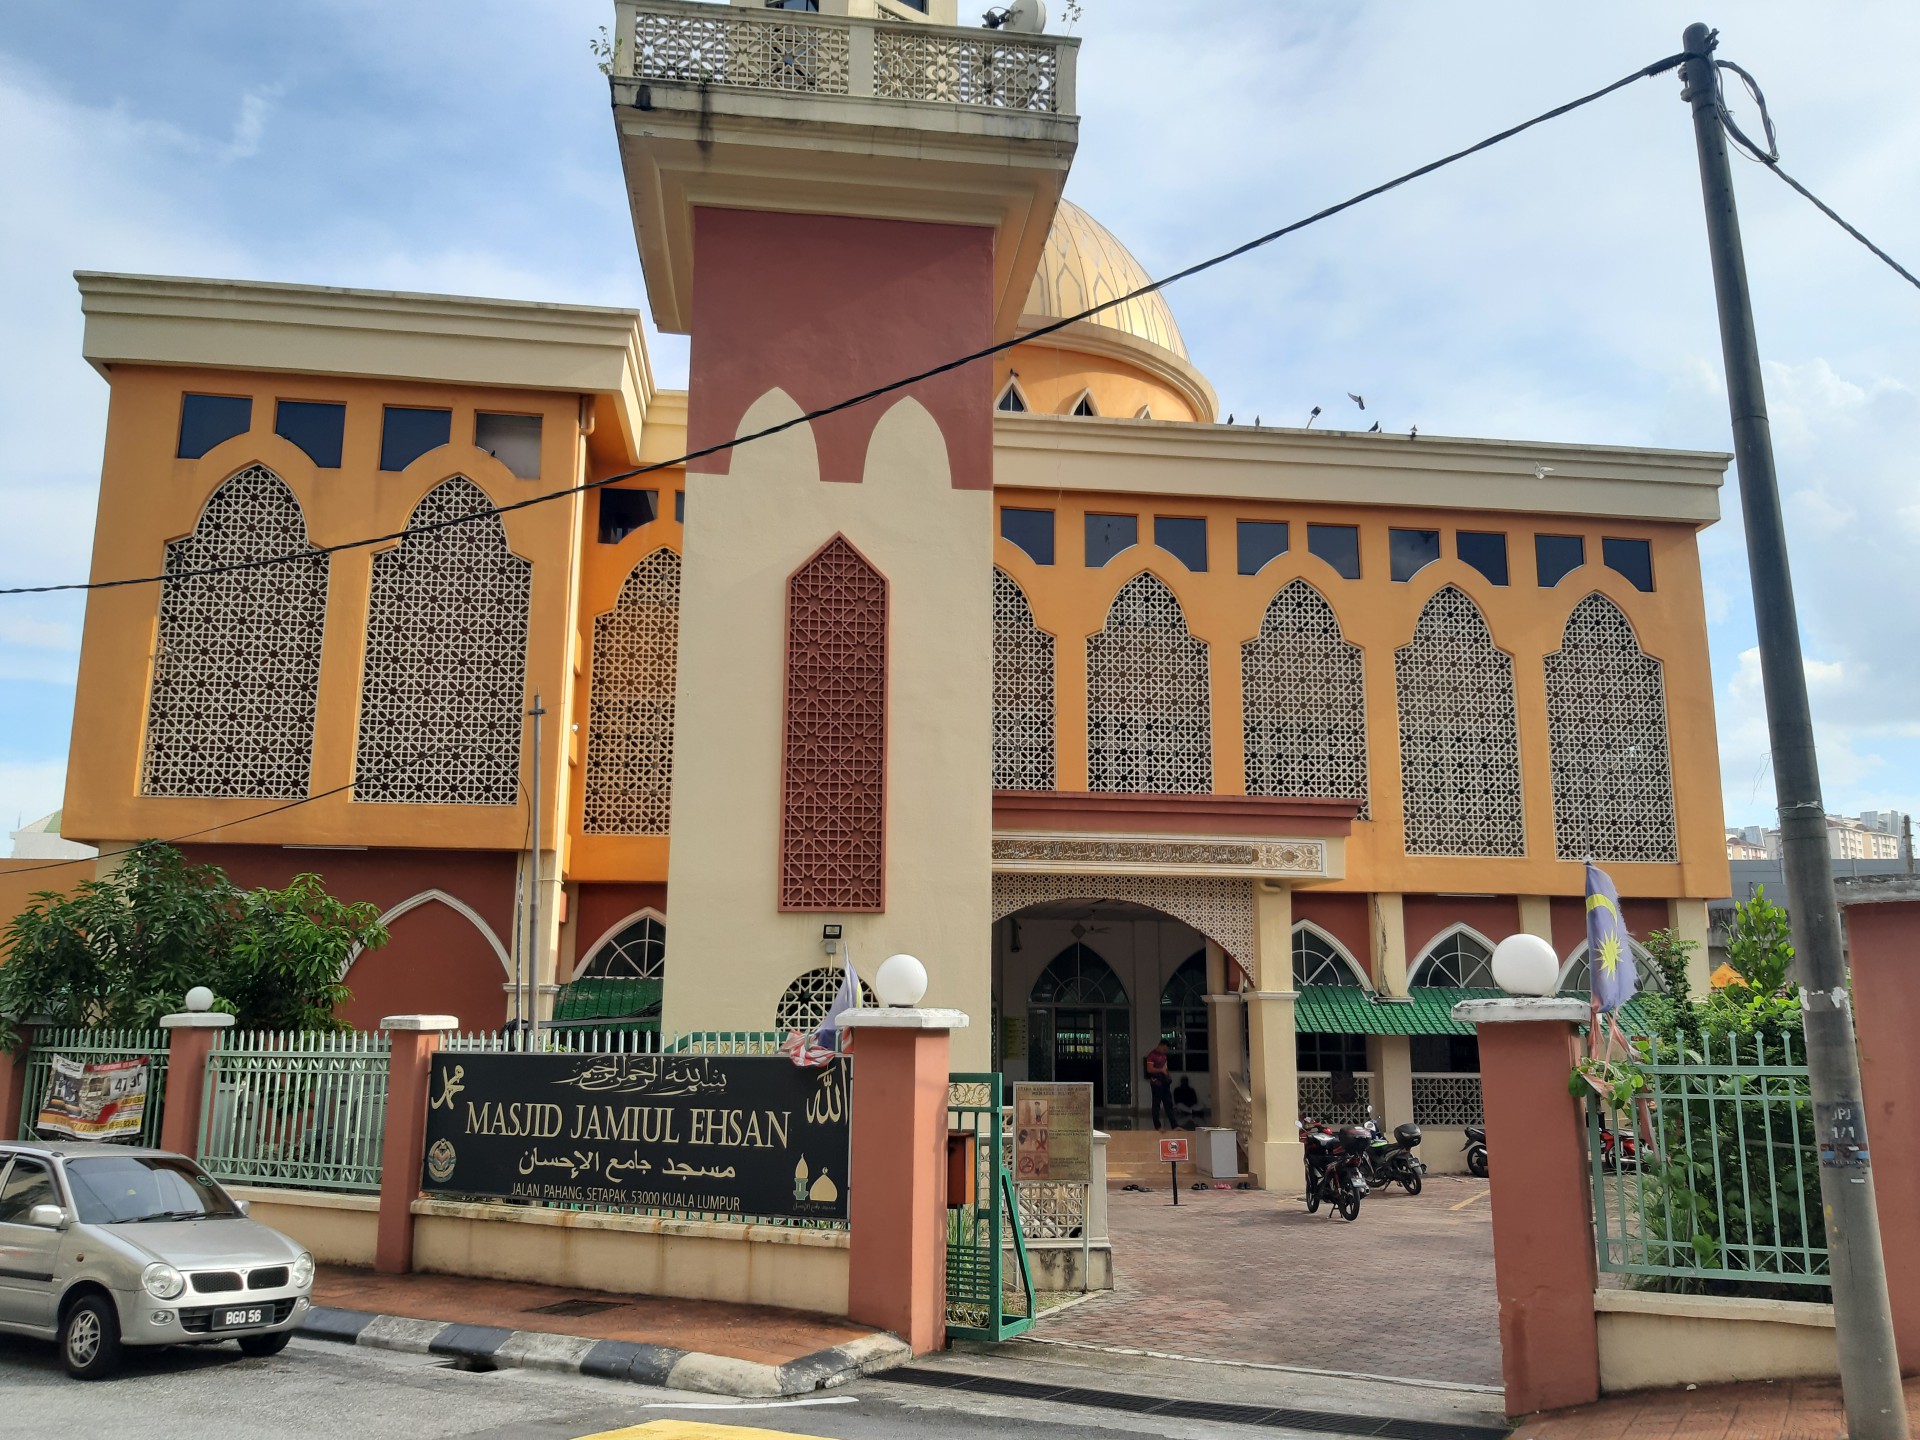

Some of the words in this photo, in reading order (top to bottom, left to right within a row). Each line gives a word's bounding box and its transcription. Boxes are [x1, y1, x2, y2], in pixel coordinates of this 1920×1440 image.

[465, 1101, 563, 1138] MASJID
[570, 1104, 680, 1143] JAMIUL
[688, 1108, 792, 1149] EHSAN
[605, 1149, 652, 1183] جامع
[662, 1157, 736, 1180] مسجد
[511, 1182, 540, 1197] JALAN
[544, 1184, 584, 1201] PAHANG,
[631, 1190, 660, 1205] 53000
[662, 1192, 695, 1207] KUALA
[697, 1194, 741, 1211] LUMPUR
[248, 1309, 262, 1323] 56
